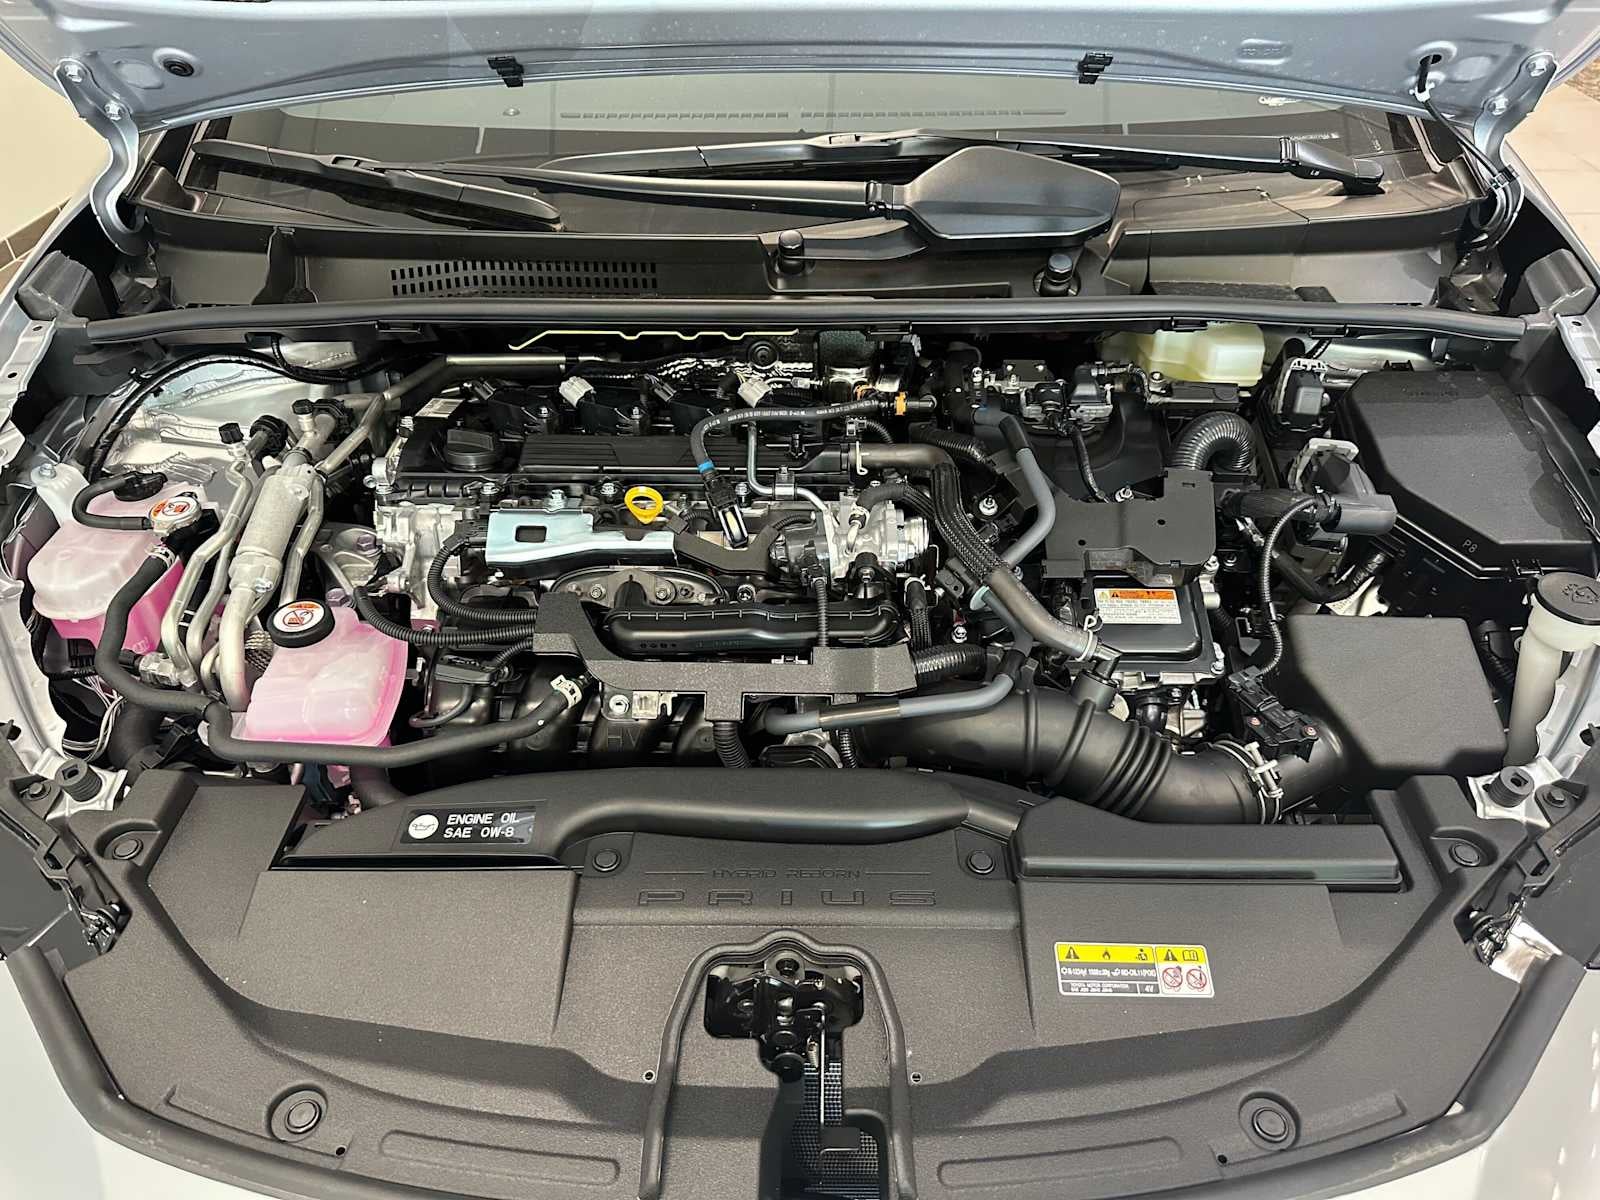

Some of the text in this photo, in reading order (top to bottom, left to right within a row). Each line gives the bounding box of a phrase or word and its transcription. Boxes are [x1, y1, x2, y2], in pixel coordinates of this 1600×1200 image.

[447, 812, 520, 825] ENGINE OIL
[443, 827, 473, 839] SAE
[712, 869, 860, 879] HYBRID REBORN
[638, 889, 936, 906] PRIUS
